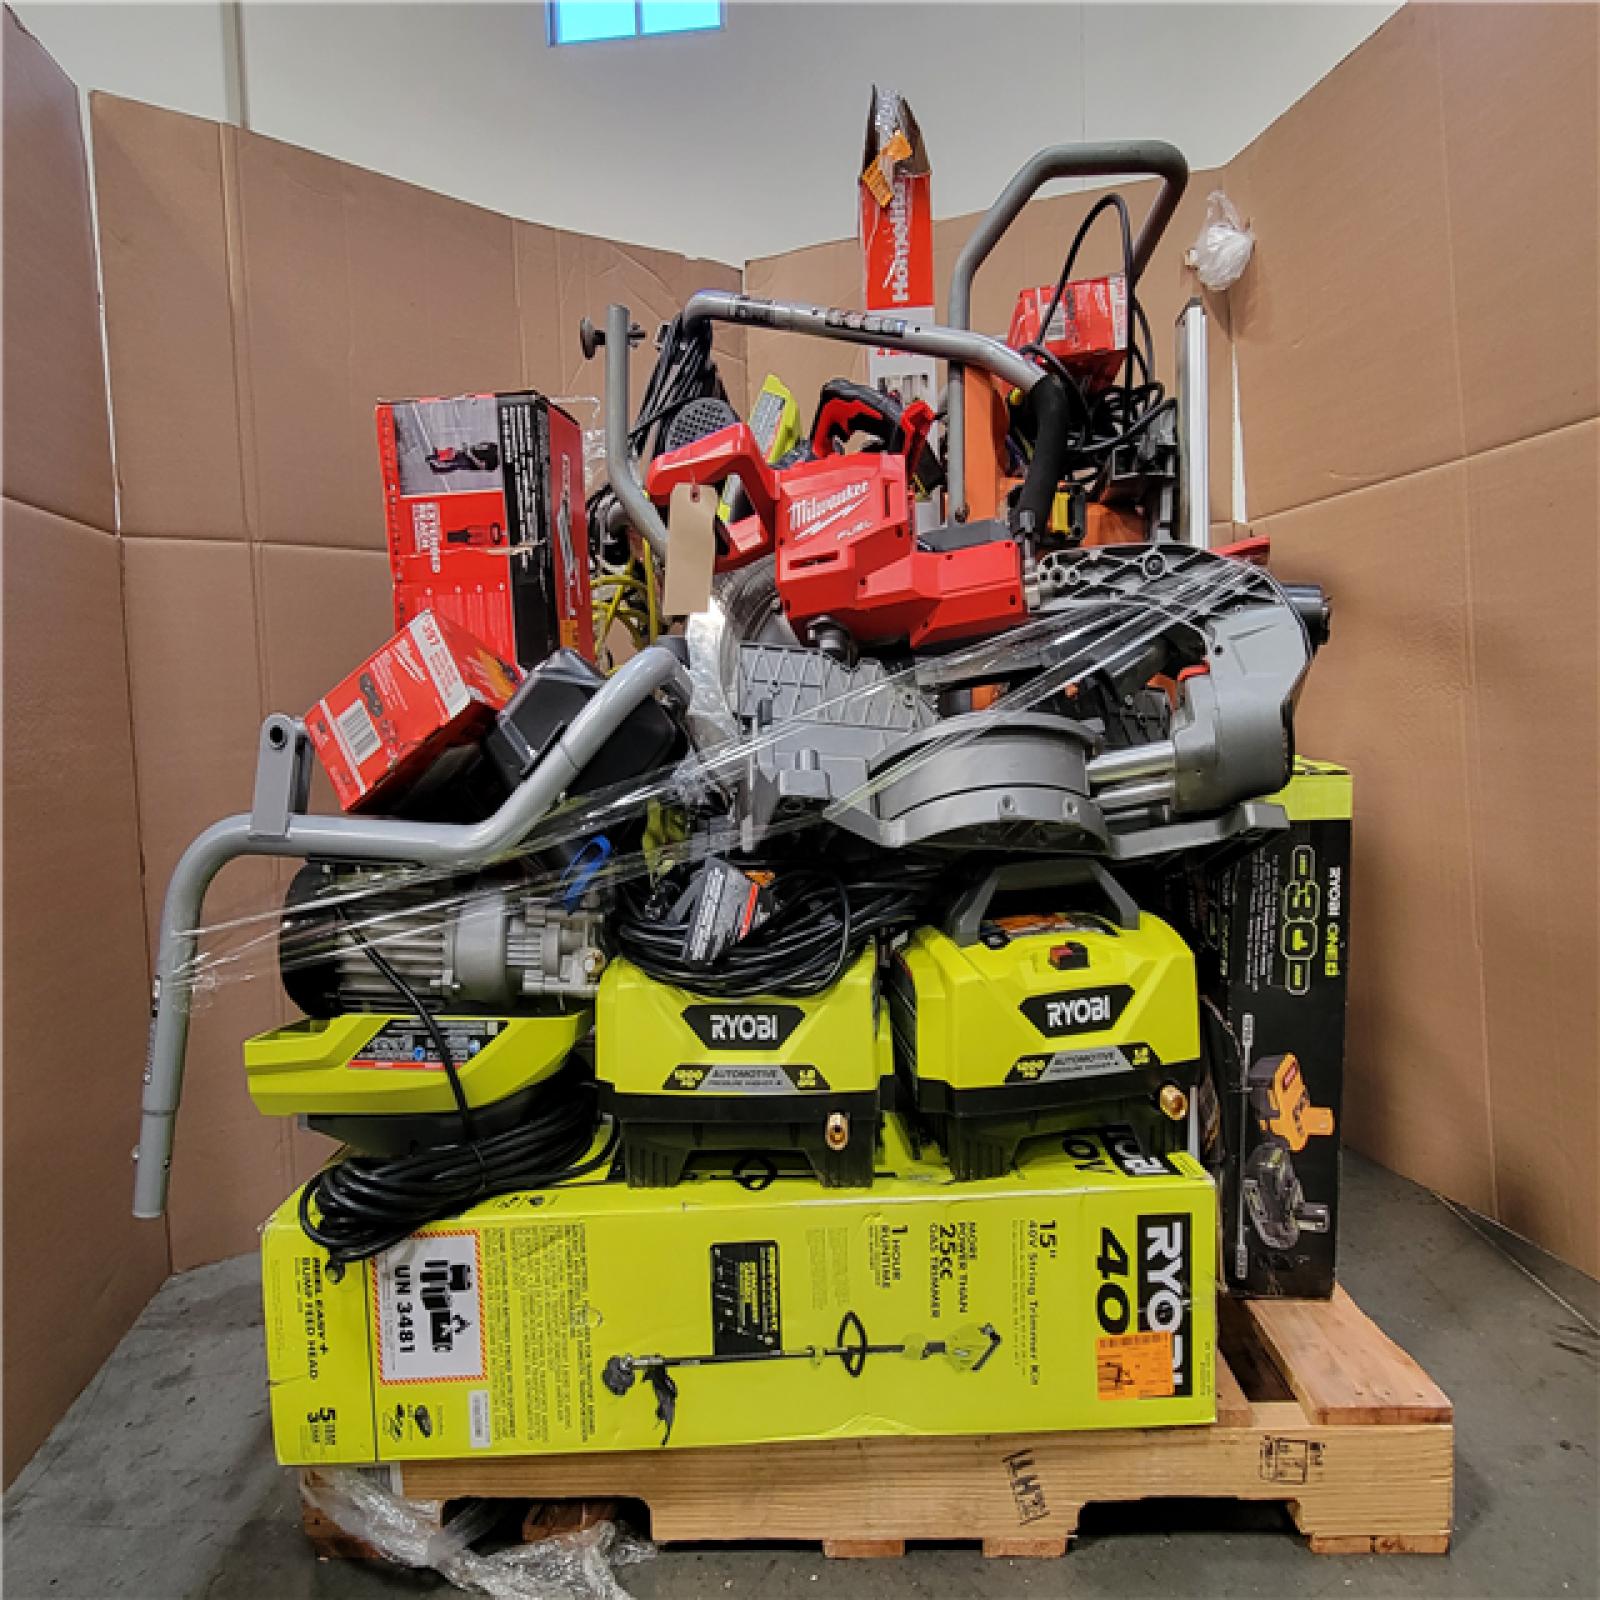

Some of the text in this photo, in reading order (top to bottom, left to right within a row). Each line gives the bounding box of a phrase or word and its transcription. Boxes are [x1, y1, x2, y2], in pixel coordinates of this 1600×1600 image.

[789, 480, 869, 531] Milwaukee
[709, 1014, 779, 1041] RYOBI
[1046, 994, 1111, 1028] RYOBI
[891, 1239, 902, 1281] HOUR
[939, 1223, 956, 1281] 25cc
[958, 1221, 969, 1314] POWER THAN
[1027, 1252, 1039, 1296] String
[394, 1264, 416, 1354] UN 3481
[929, 1256, 941, 1319] TRIMMER
[1028, 1300, 1039, 1360] Trimmer
[307, 1339, 319, 1381] HEAD
